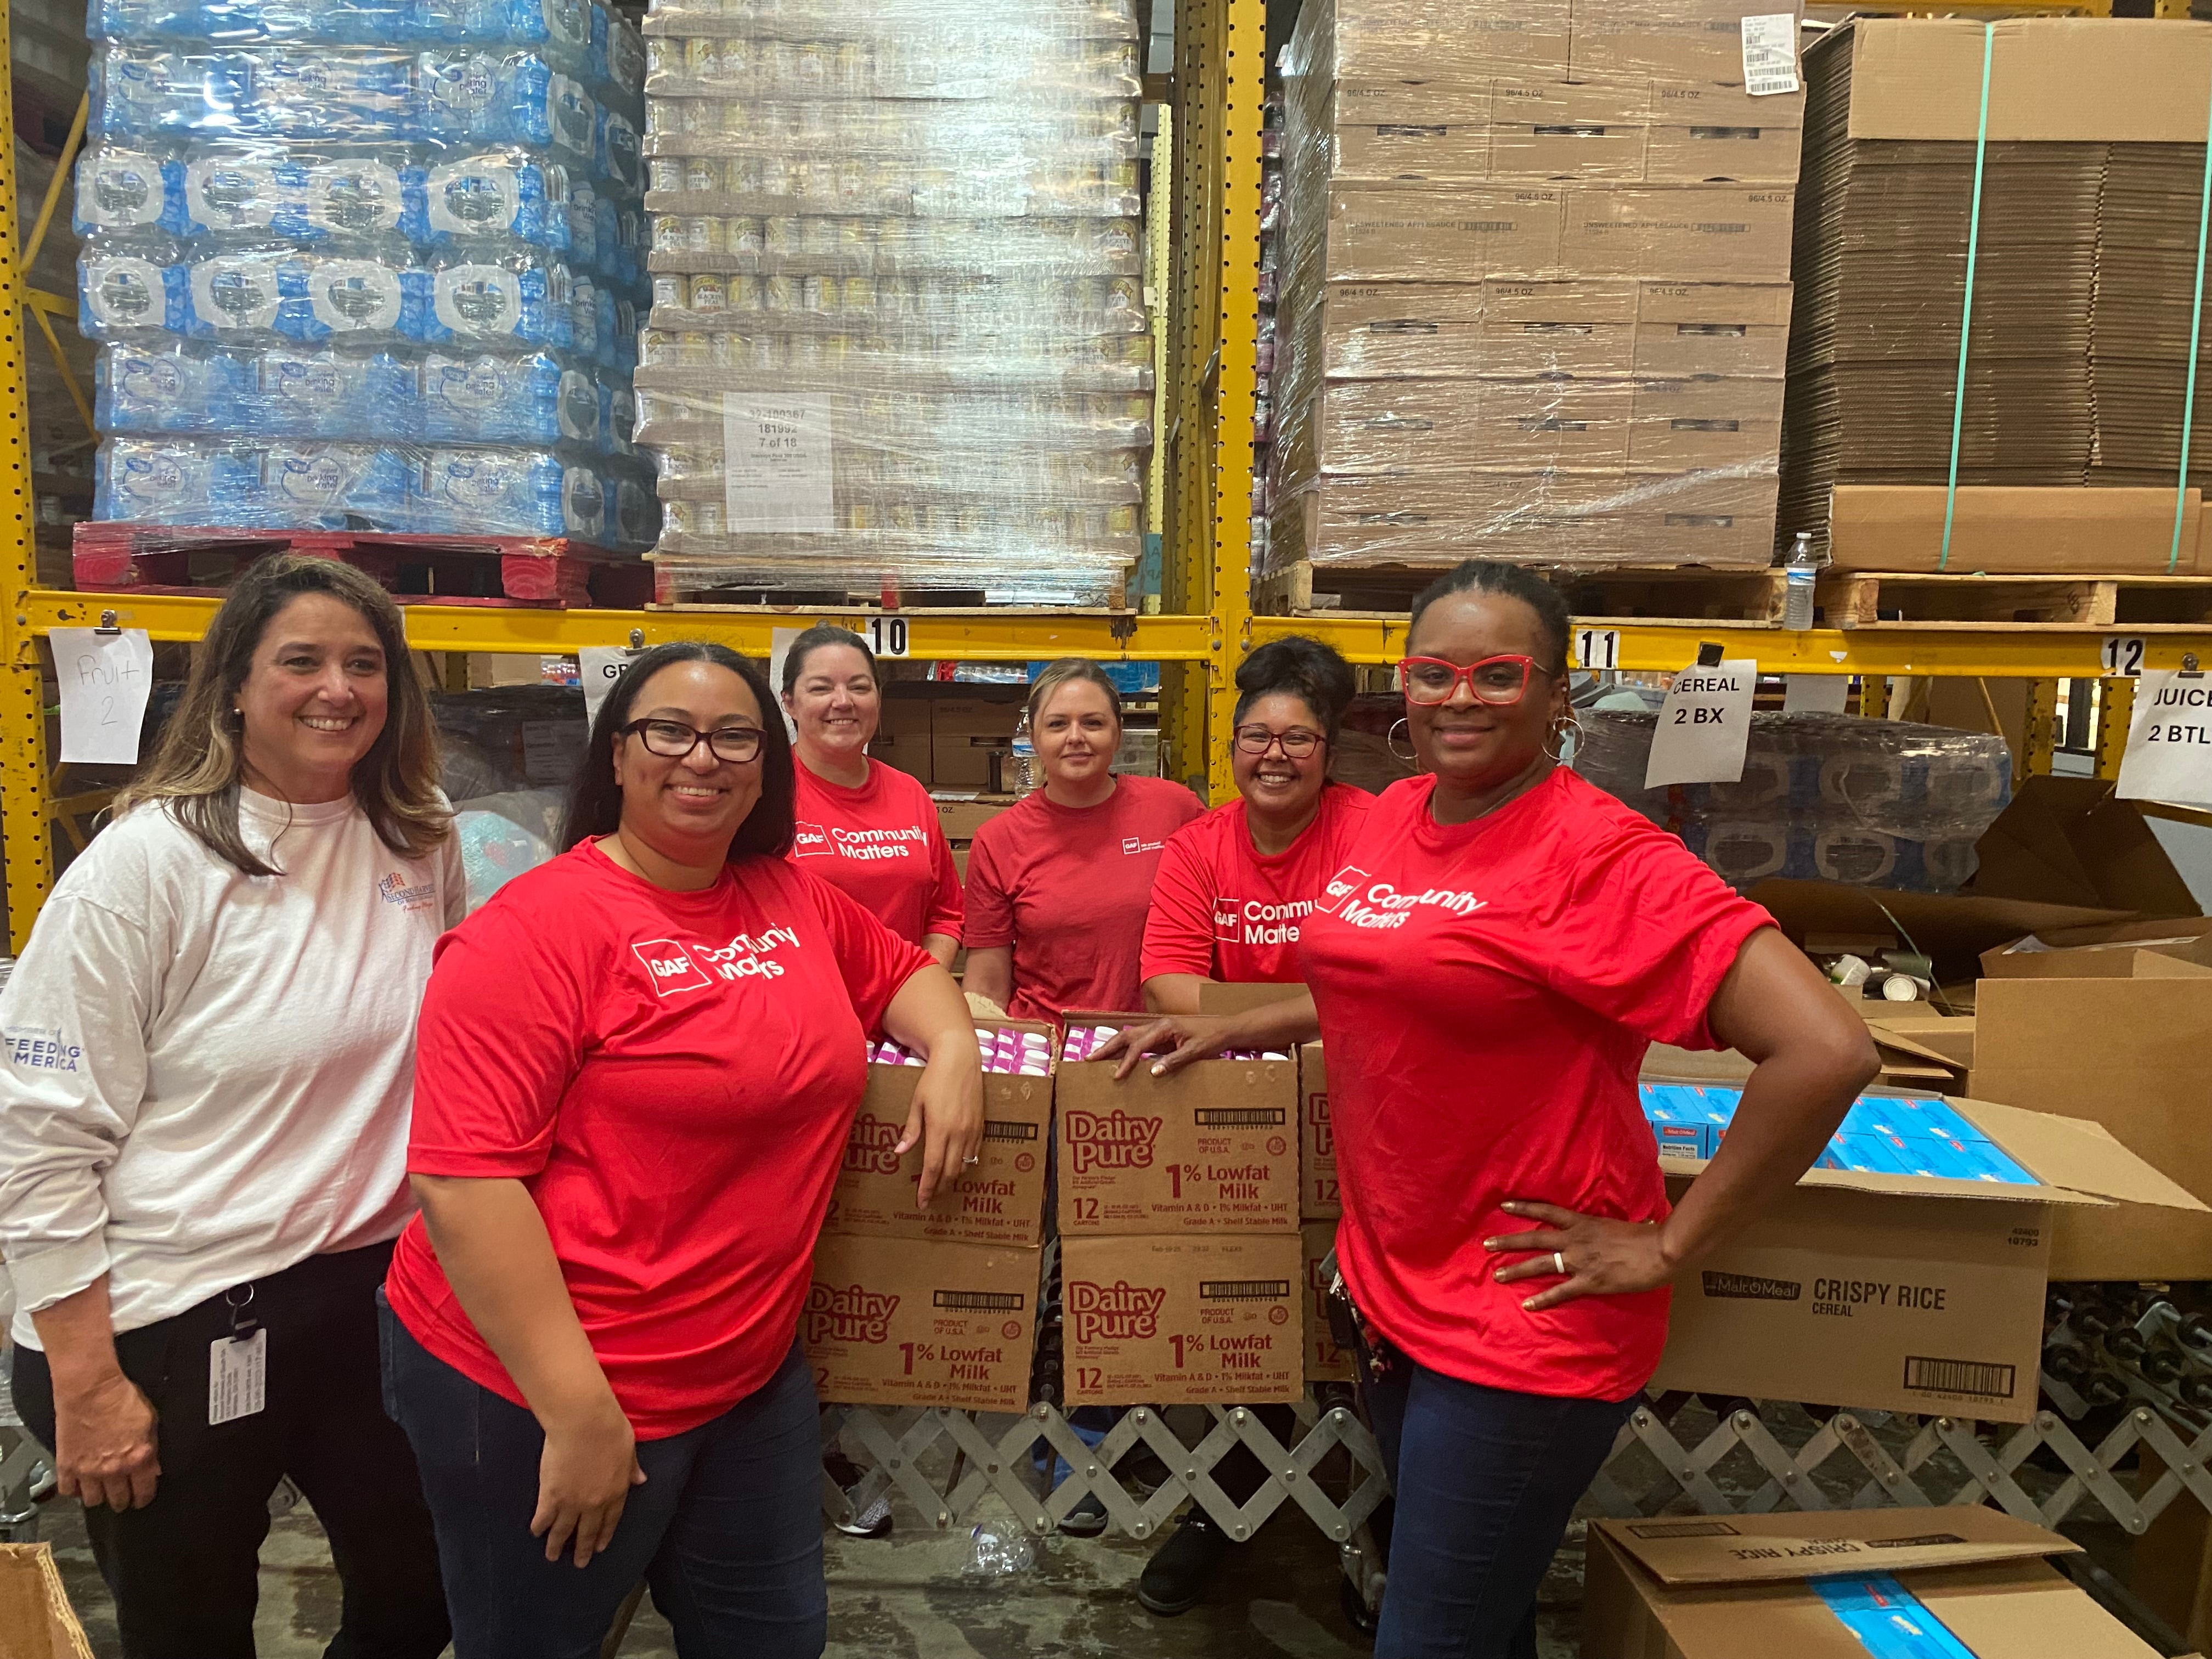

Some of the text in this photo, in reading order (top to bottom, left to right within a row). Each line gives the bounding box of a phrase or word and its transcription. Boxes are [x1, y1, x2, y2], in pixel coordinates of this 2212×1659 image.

[759, 438, 797, 448] 7 of 18
[872, 618, 906, 655] 10
[1582, 631, 1615, 668] 11
[2108, 639, 2143, 676] 12
[77, 654, 140, 685] Fruit
[1673, 678, 1740, 695] CEREAL
[101, 696, 118, 725] 2
[1674, 708, 1725, 724] 2 BX
[2148, 725, 2211, 744] 2 BTL
[796, 833, 824, 844] GAF
[838, 842, 909, 860] Matters
[1326, 881, 1355, 898] GAF
[1368, 883, 1488, 916] Comunity
[1214, 911, 1237, 927] GAF
[692, 922, 800, 962] Comuniy
[651, 956, 690, 977] GAF
[4, 1038, 81, 1058] FEEDING
[8, 1049, 77, 1072] MERICA
[849, 1113, 907, 1149] airy
[1065, 1109, 1163, 1144] Dairy
[842, 1144, 900, 1175] ure
[1073, 1141, 1153, 1174] Pure
[952, 1179, 1015, 1197] Lowfat
[1165, 1164, 1270, 1199] 1% Lowfat
[1219, 1183, 1260, 1199] Milk
[962, 1196, 1003, 1215] Milk
[1073, 1197, 1099, 1219] 12
[1151, 1203, 1184, 1212] Vitamin
[1187, 1203, 1193, 1211] A
[1194, 1203, 1201, 1211] &
[1203, 1204, 1210, 1212] D
[1220, 1203, 1231, 1212] 1%
[1232, 1203, 1262, 1212] Milkfat
[1271, 1203, 1288, 1212] UHT
[893, 1210, 926, 1222] Vitamin
[945, 1214, 952, 1223] D
[975, 1217, 1003, 1227] Milkfat
[1013, 1219, 1031, 1228] UHT
[1183, 1217, 1207, 1225] Grade
[923, 1227, 948, 1235] Grade
[964, 1229, 985, 1238] Shelf
[1012, 1233, 1029, 1242] Milk
[803, 1282, 901, 1323] Dairy
[1069, 1280, 1166, 1316] Dairy
[1814, 1278, 1891, 1305] CRISPY
[1898, 1285, 1946, 1311] RICE
[1812, 1302, 1854, 1317] CEREAL
[808, 1312, 888, 1344] Pure
[933, 1319, 968, 1327] PRODUCT
[1076, 1312, 1157, 1344] Pure
[899, 1342, 1003, 1375] 1% Lowfat
[1168, 1334, 1272, 1368] 1% Lowfat
[1221, 1352, 1262, 1368] Milk
[950, 1364, 991, 1380] Milk
[1077, 1367, 1103, 1389] 12
[1154, 1373, 1187, 1382] Vitamin
[1189, 1373, 1195, 1381] A
[1197, 1373, 1204, 1381] &
[1206, 1373, 1212, 1381] D
[1222, 1372, 1233, 1381] 1%
[1235, 1372, 1263, 1381] Milkfat
[1273, 1372, 1289, 1380] UHT
[882, 1379, 915, 1387] Vitamin
[962, 1383, 990, 1392] Milkfat
[1000, 1385, 1018, 1393] UHT
[1186, 1386, 1209, 1395] Grade
[1225, 1386, 1245, 1394] Shelf
[1273, 1385, 1289, 1393] Milk
[1728, 1542, 1861, 1560] CRISPY RICE
